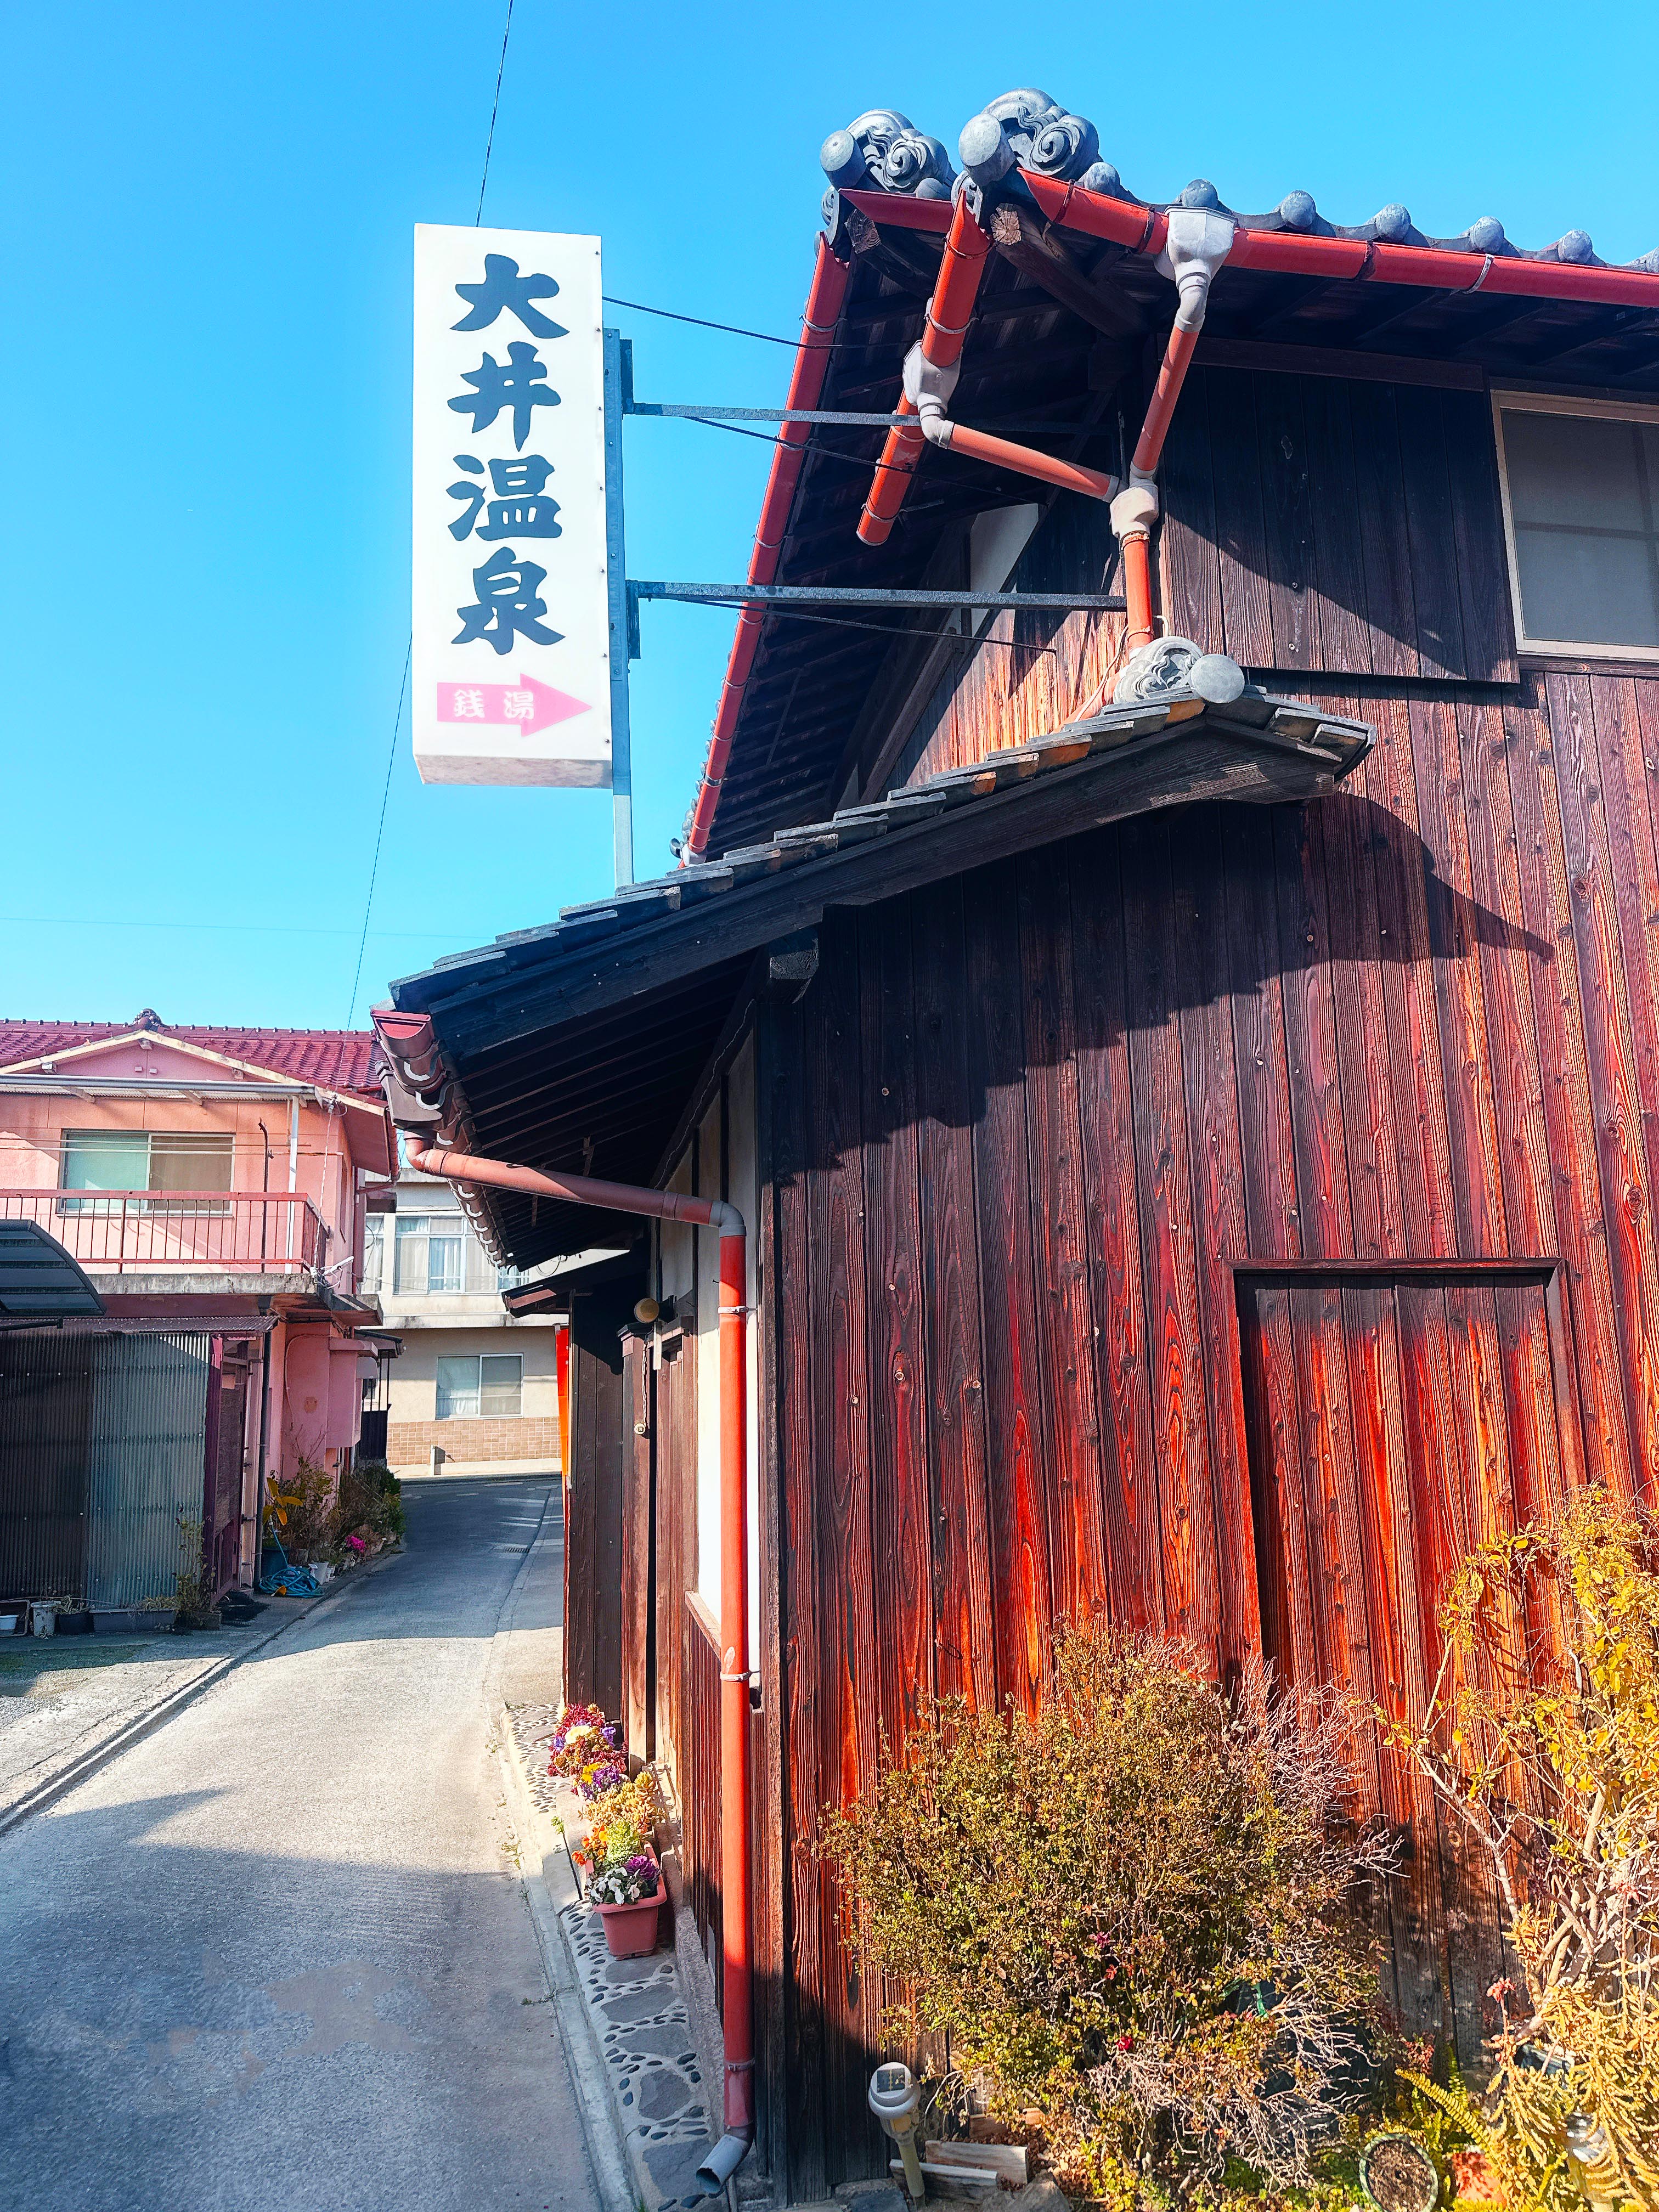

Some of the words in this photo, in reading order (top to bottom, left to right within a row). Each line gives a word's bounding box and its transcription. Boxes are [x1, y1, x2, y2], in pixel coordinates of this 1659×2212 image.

[445, 253, 570, 655] 大井温泉
[453, 689, 534, 720] 銭湯
